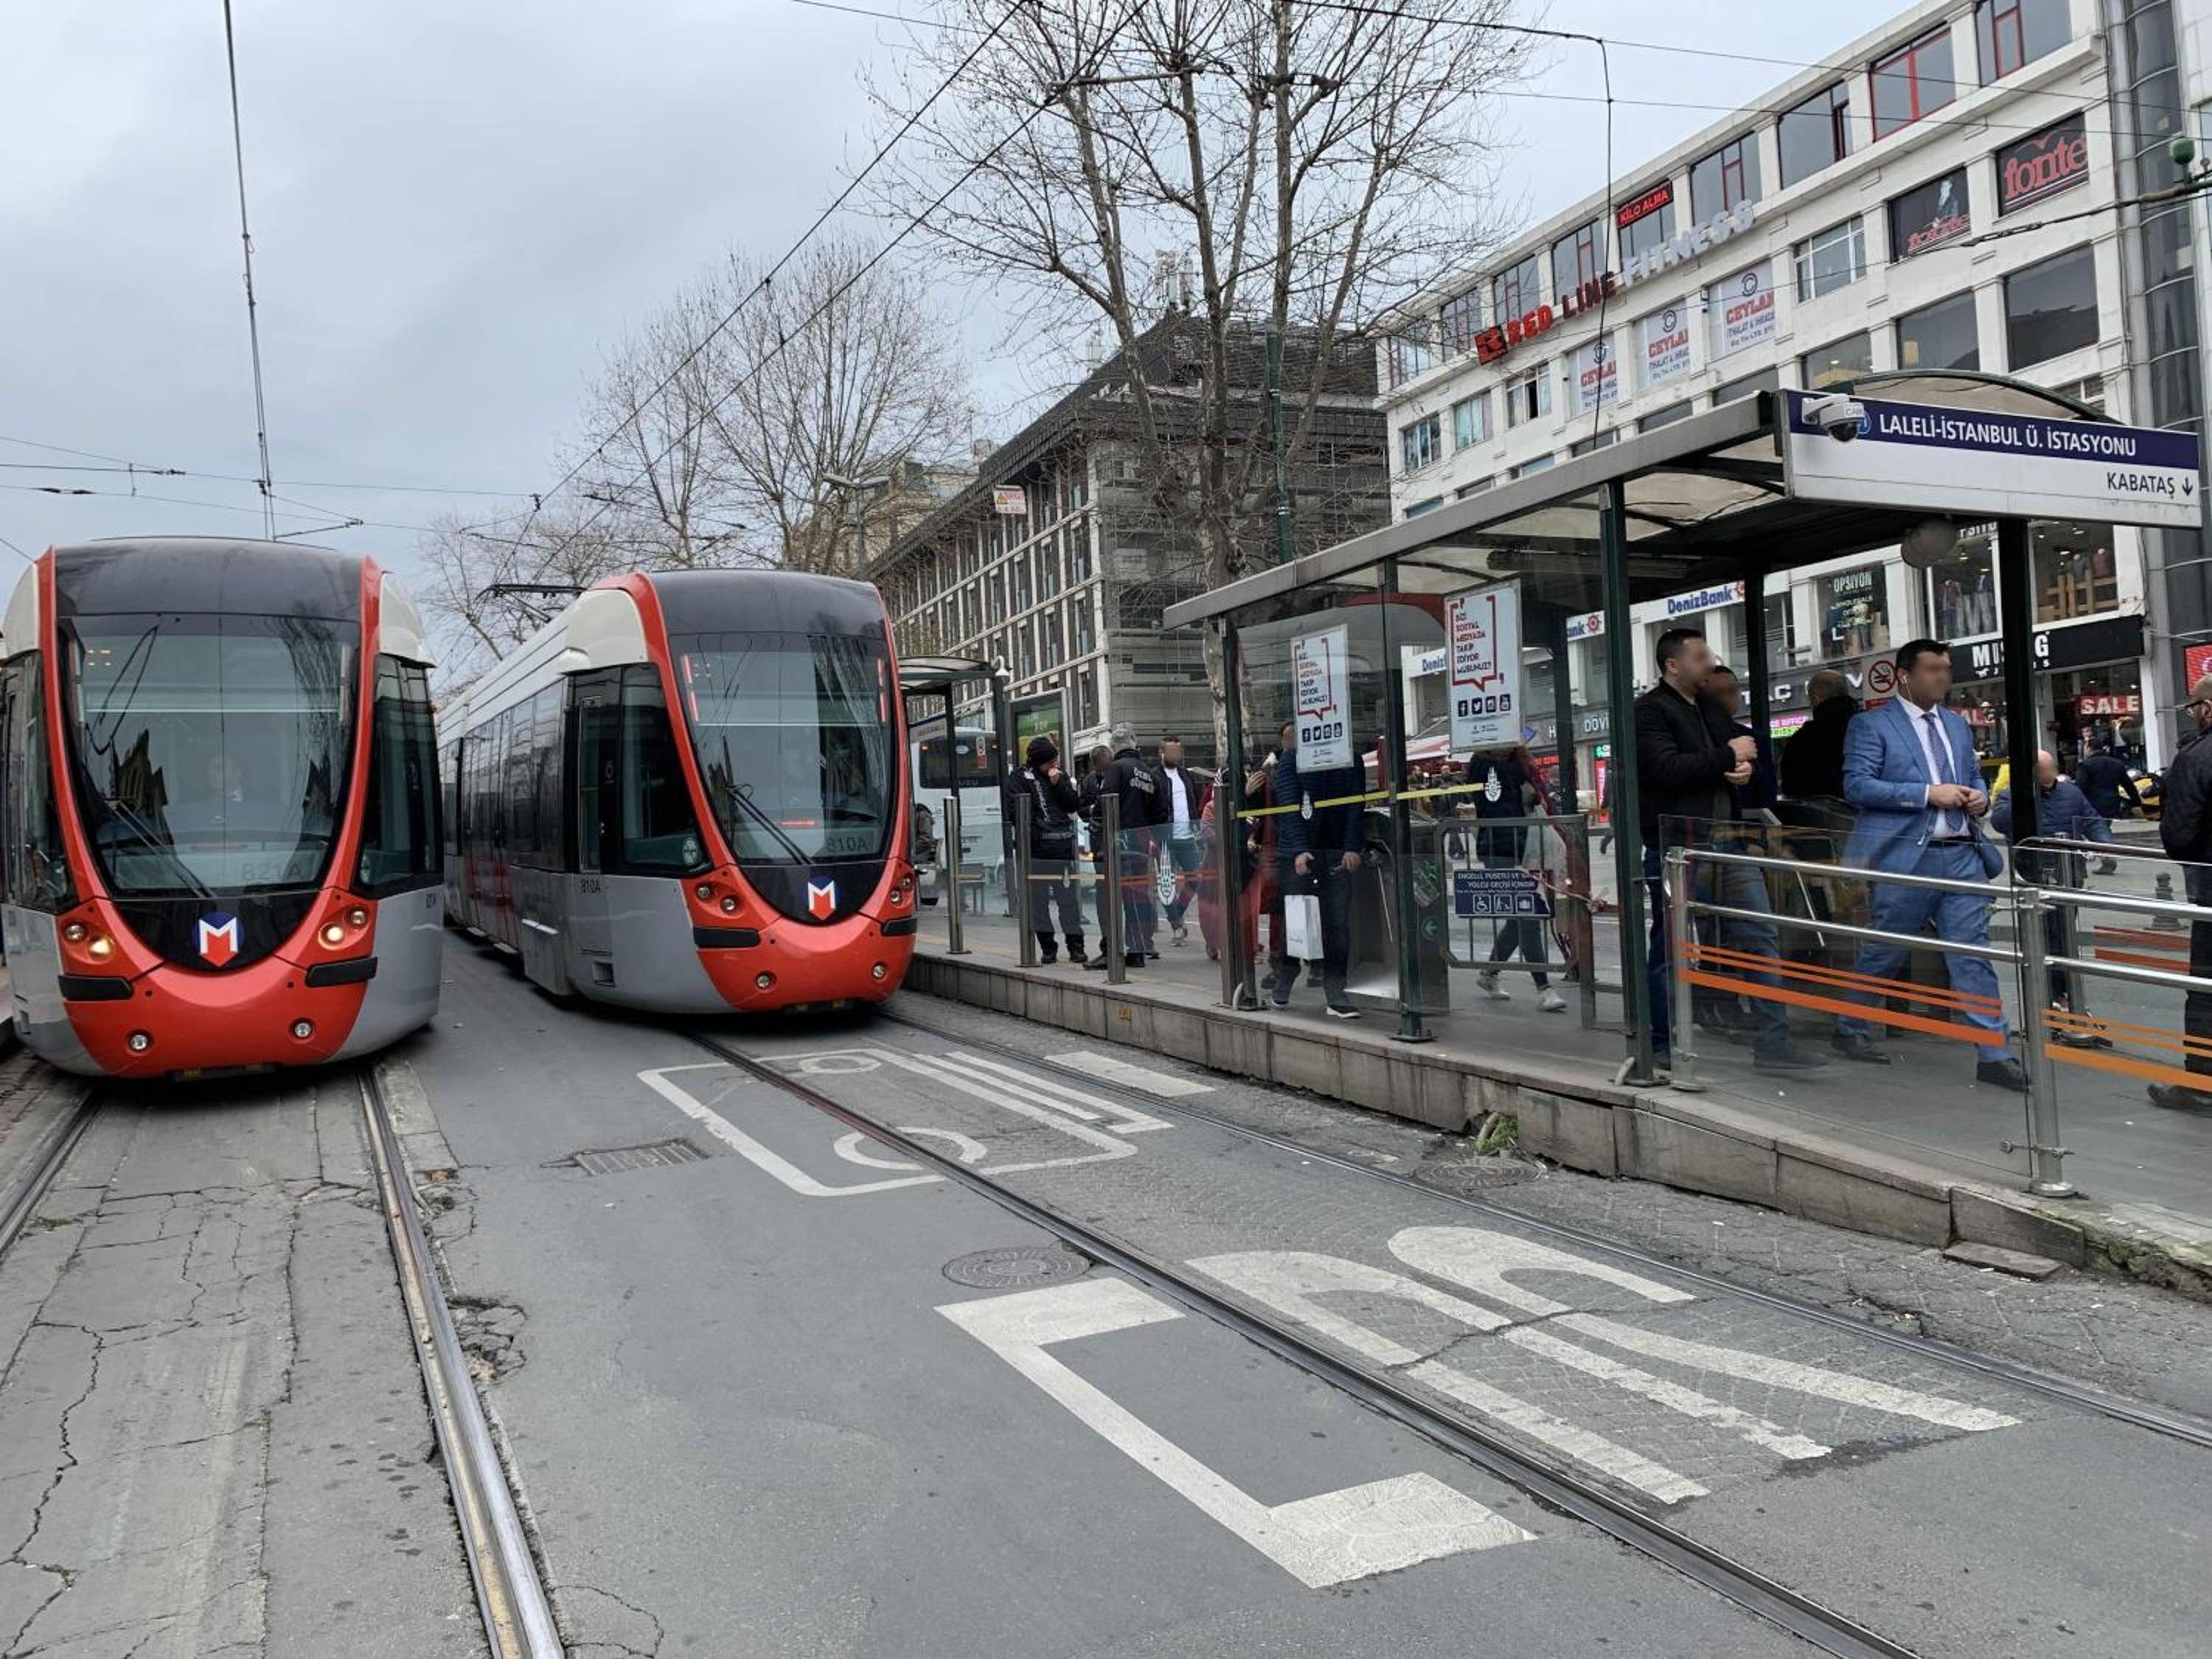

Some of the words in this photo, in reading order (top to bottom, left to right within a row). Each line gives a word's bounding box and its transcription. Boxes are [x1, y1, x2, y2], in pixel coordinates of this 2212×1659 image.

[1507, 305, 1553, 347] RED
[1562, 271, 1617, 319] LINE
[1621, 199, 1755, 288] FITNESS
[1879, 414, 2023, 445] LALELİ-İSTANBUL
[2025, 424, 2043, 448] Ü.
[2047, 425, 2136, 456] İSTASYONU
[2107, 471, 2175, 499] KABATAŞ
[1667, 585, 1733, 614] DenizBank
[2081, 695, 2140, 715] SALE
